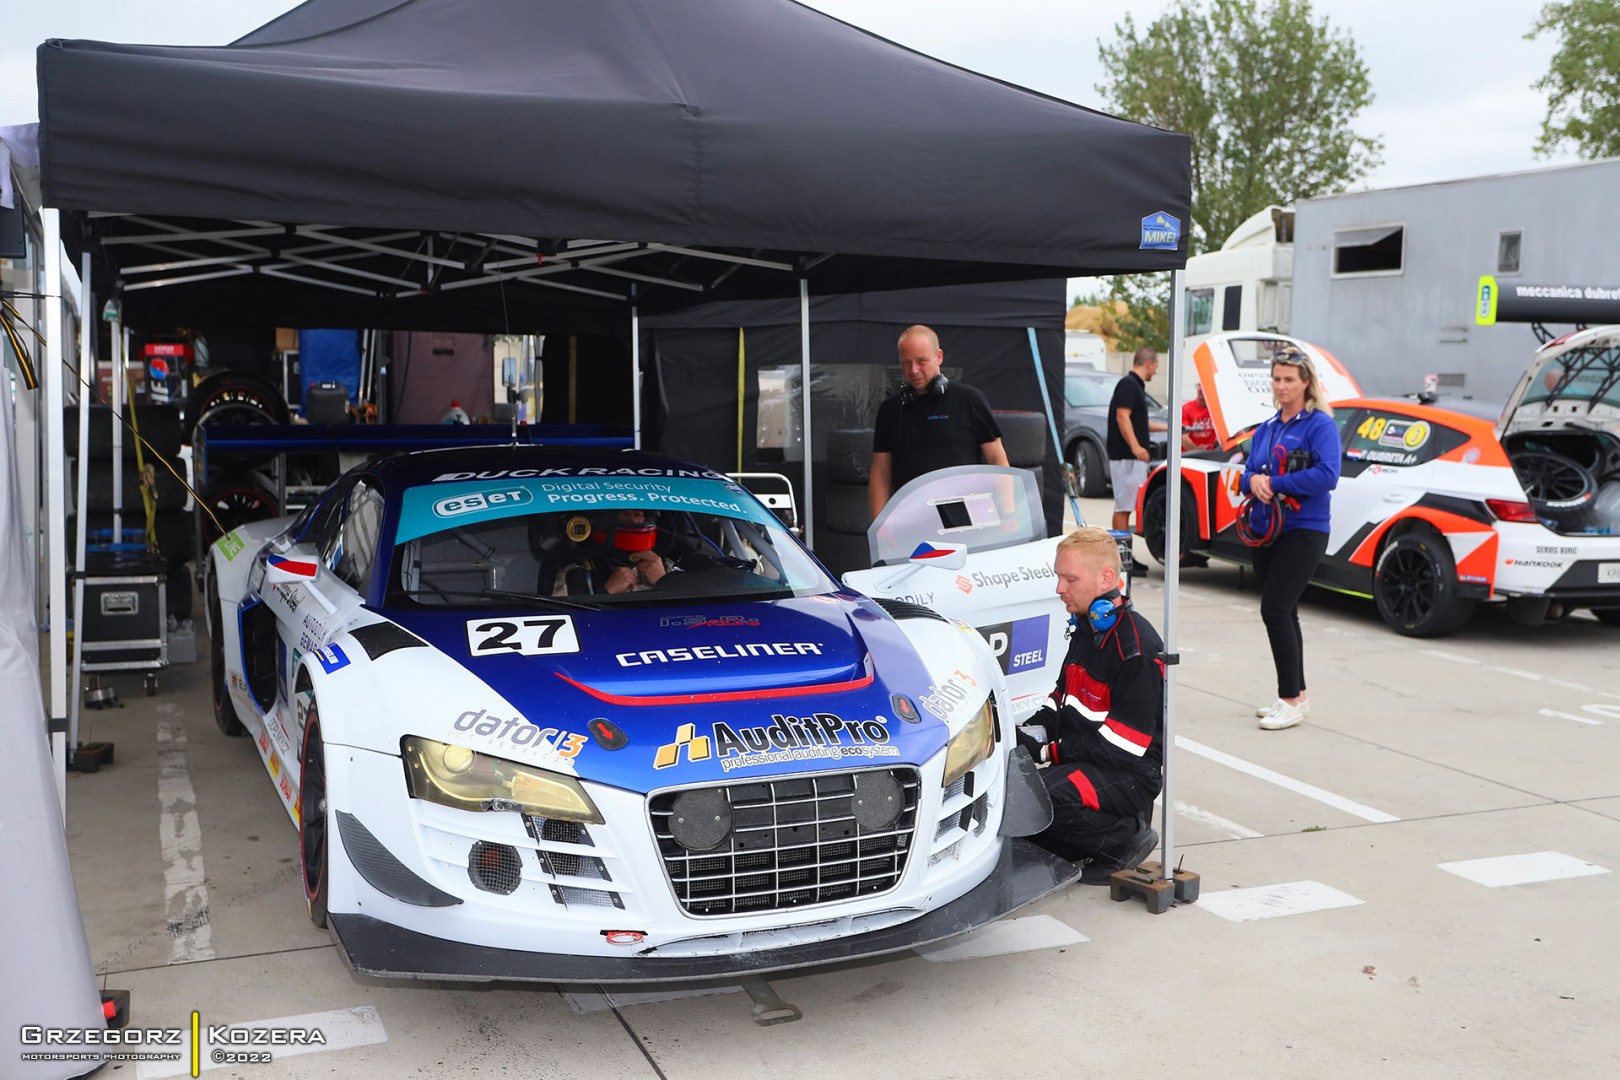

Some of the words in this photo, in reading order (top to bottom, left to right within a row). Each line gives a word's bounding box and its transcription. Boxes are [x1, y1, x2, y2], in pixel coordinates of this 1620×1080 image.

[1516, 285, 1583, 299] meccanica
[1357, 416, 1387, 441] 48
[433, 468, 573, 482] DUCK
[578, 467, 724, 480] RACING
[541, 482, 600, 493] Digital
[603, 481, 671, 493] Security
[547, 492, 644, 504] Progress.
[647, 492, 748, 514] Protected.
[972, 571, 1020, 590] Shape
[1019, 562, 1055, 583] Steel
[475, 619, 567, 651] 27
[616, 642, 822, 667] CASELINER
[1013, 649, 1043, 667] STEEL
[713, 713, 890, 757] AuditPro
[722, 749, 793, 772] professional
[793, 746, 841, 762] auditing
[841, 745, 900, 760] ecosystem
